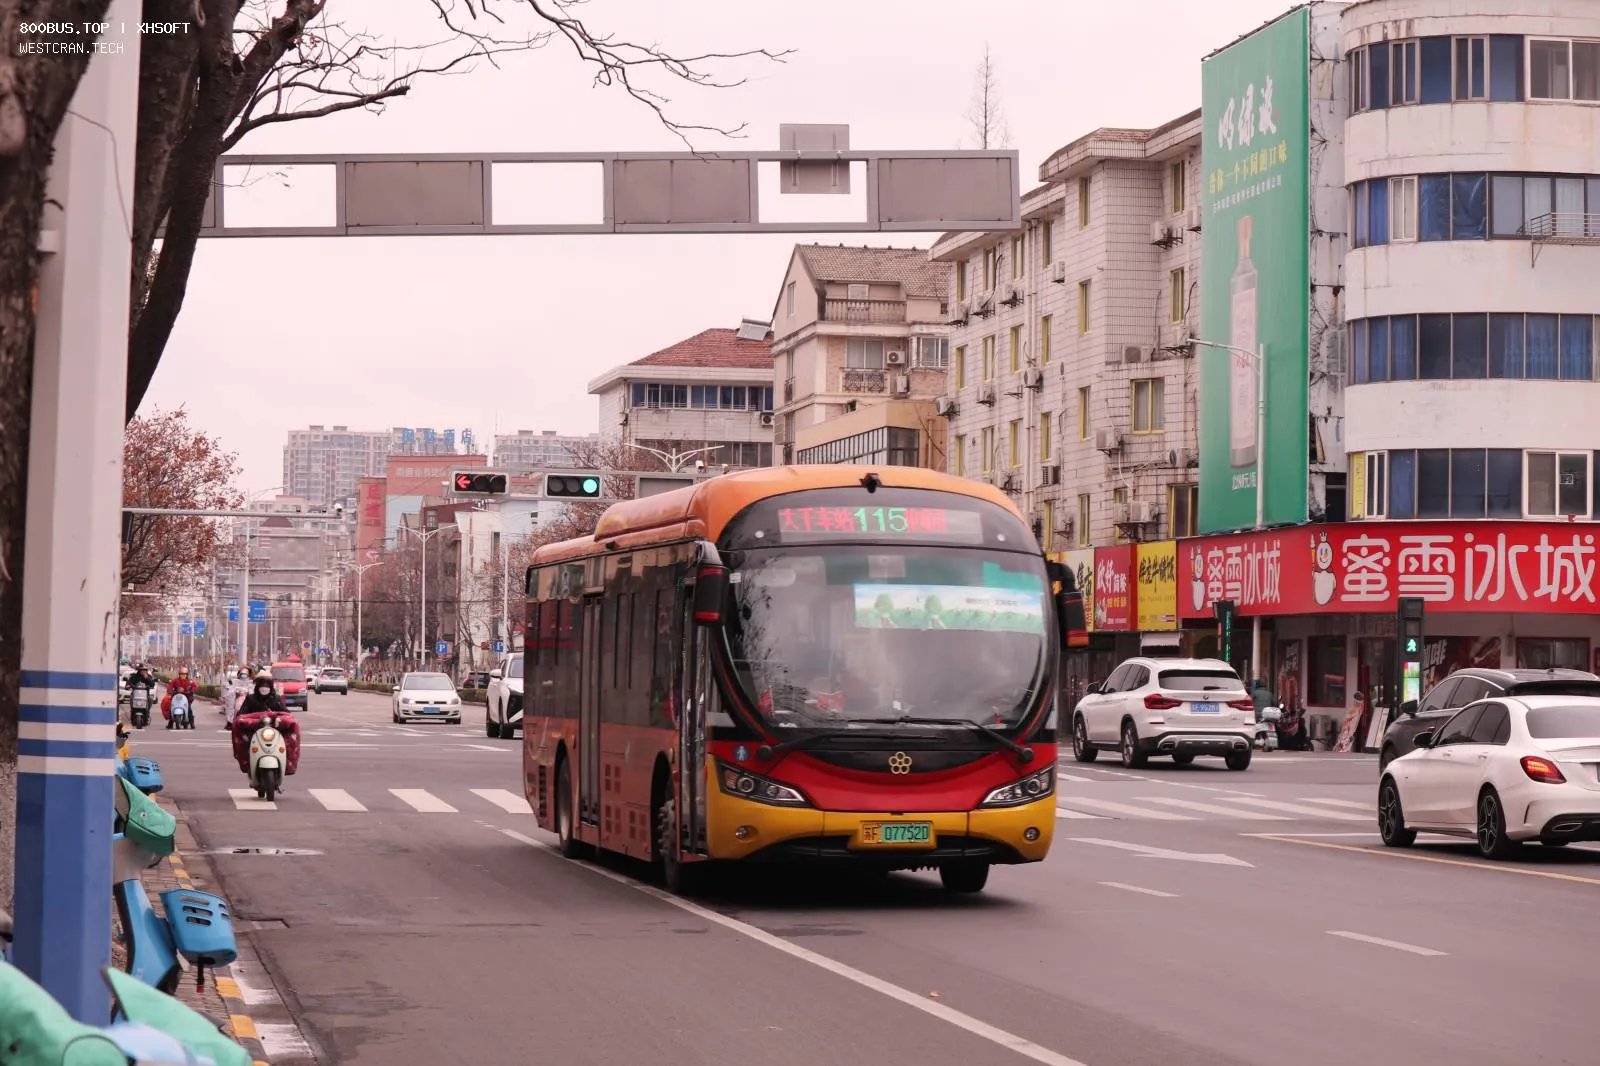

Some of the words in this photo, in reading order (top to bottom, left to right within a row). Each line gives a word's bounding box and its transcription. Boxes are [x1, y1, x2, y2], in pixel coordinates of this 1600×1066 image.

[853, 507, 908, 532] 115
[1207, 540, 1281, 606] 蜜雪冰城
[1340, 532, 1597, 603] 蜜雪冰城
